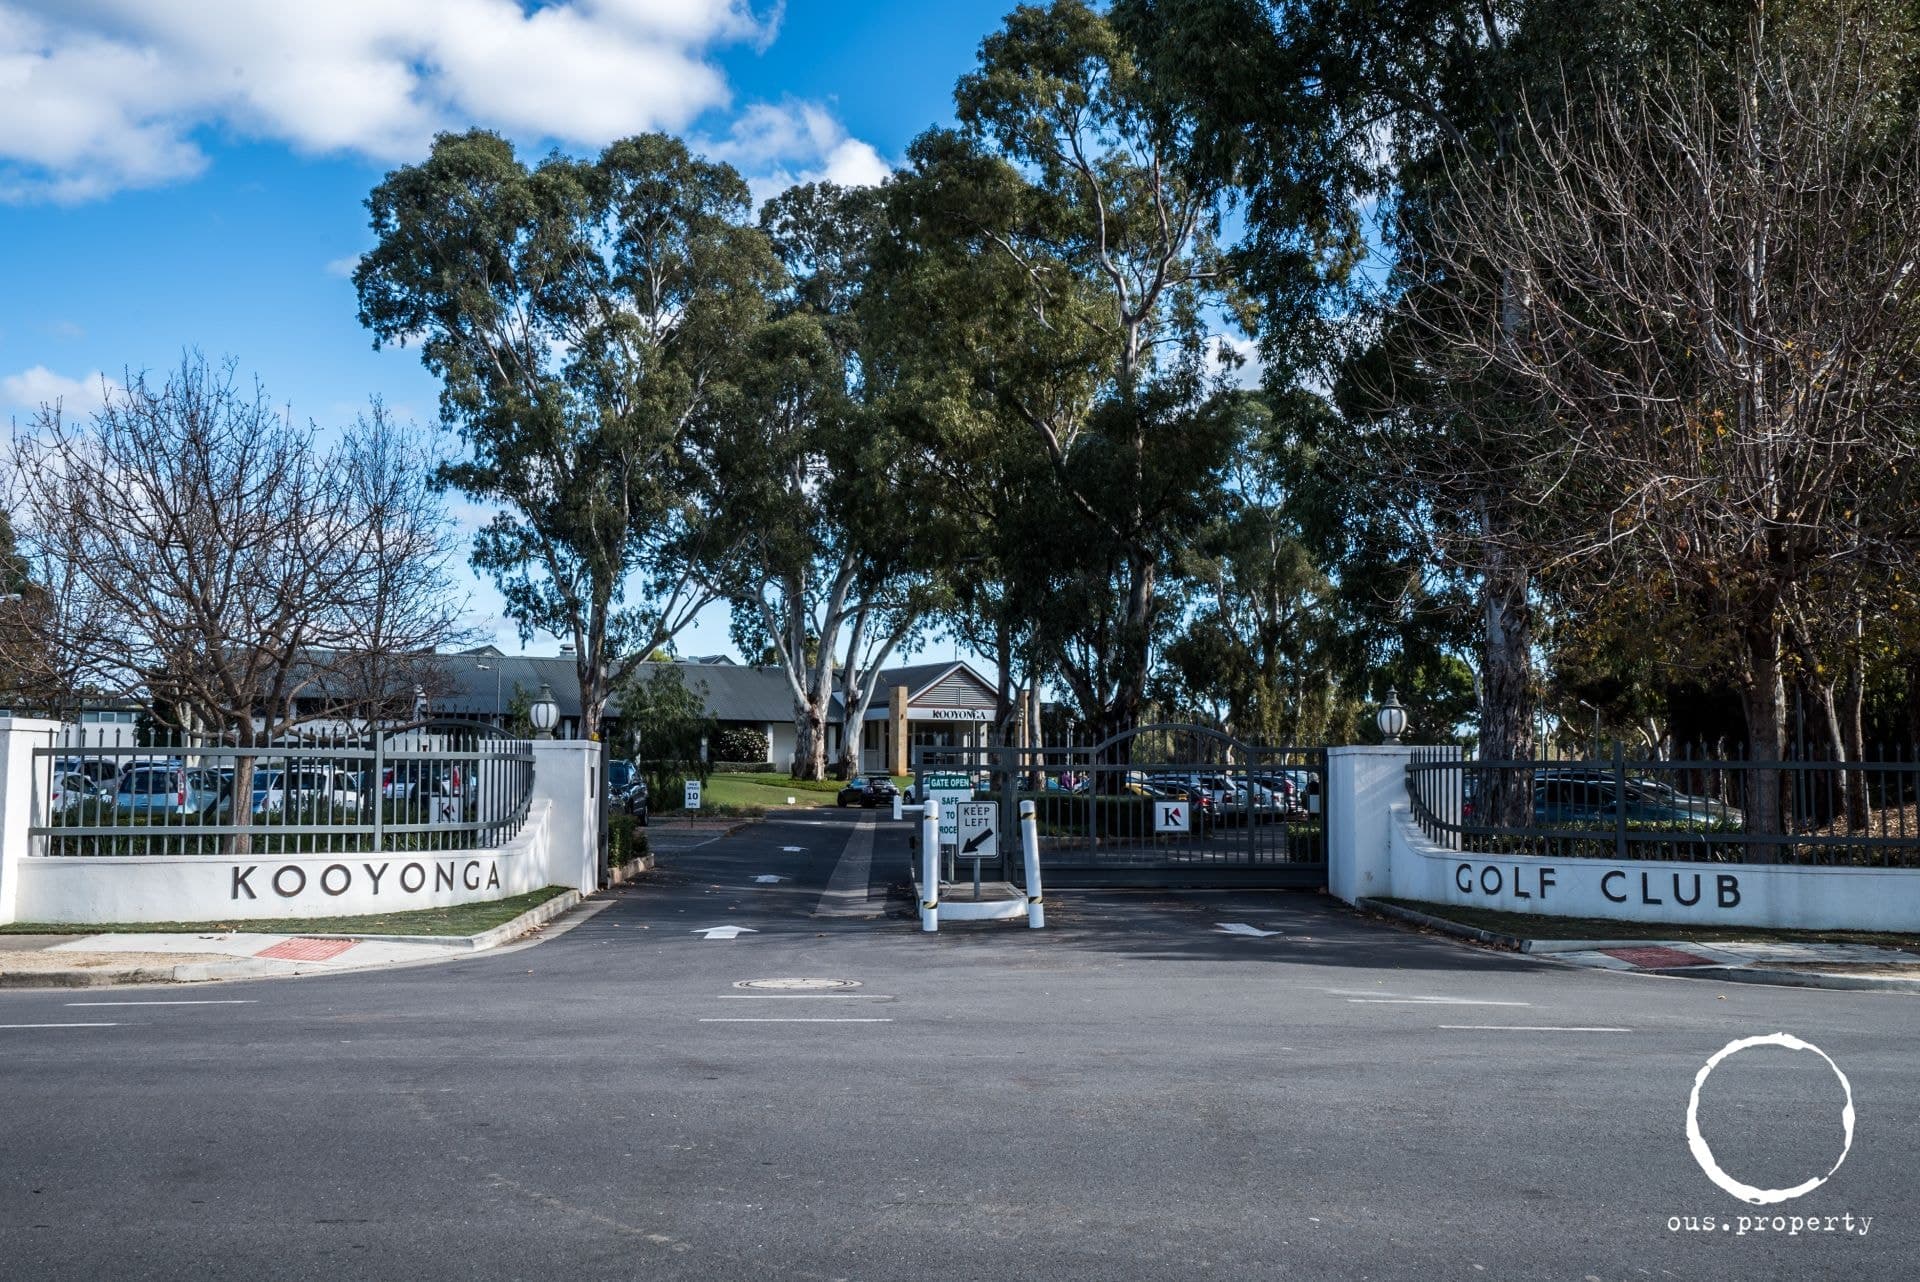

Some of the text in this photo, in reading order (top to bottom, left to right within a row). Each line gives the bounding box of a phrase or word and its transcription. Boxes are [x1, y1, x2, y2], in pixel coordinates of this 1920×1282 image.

[932, 709, 986, 720] KOOYONGA
[931, 778, 970, 788] GATE OPEN
[687, 792, 699, 801] 10
[941, 796, 959, 806] SAFE
[945, 811, 956, 820] TO
[963, 806, 990, 816] KEEP
[964, 818, 989, 827] LEFT
[231, 860, 500, 900] KOOYONGA
[1456, 863, 1741, 908] GOLF CLUB
